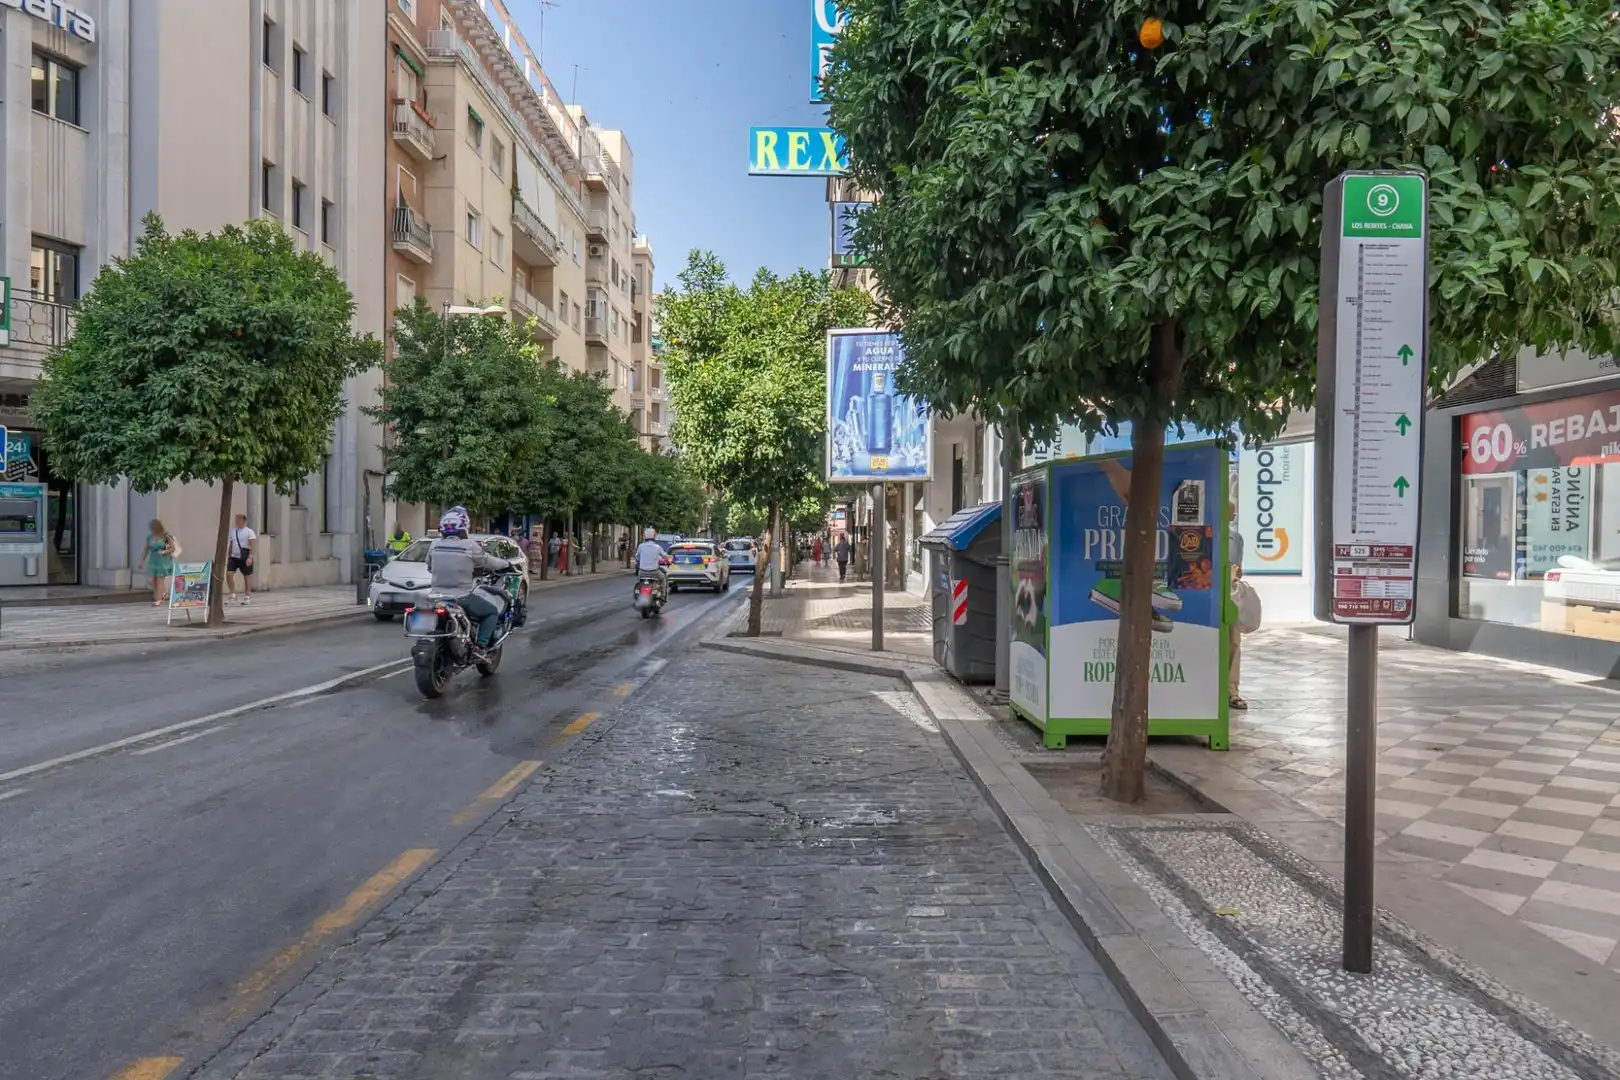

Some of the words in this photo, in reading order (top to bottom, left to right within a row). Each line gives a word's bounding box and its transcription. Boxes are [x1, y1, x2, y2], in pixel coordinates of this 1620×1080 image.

[756, 131, 847, 171] REX
[1378, 194, 1388, 206] 9
[866, 347, 893, 355] AGUA
[1084, 662, 1116, 682] ROP
